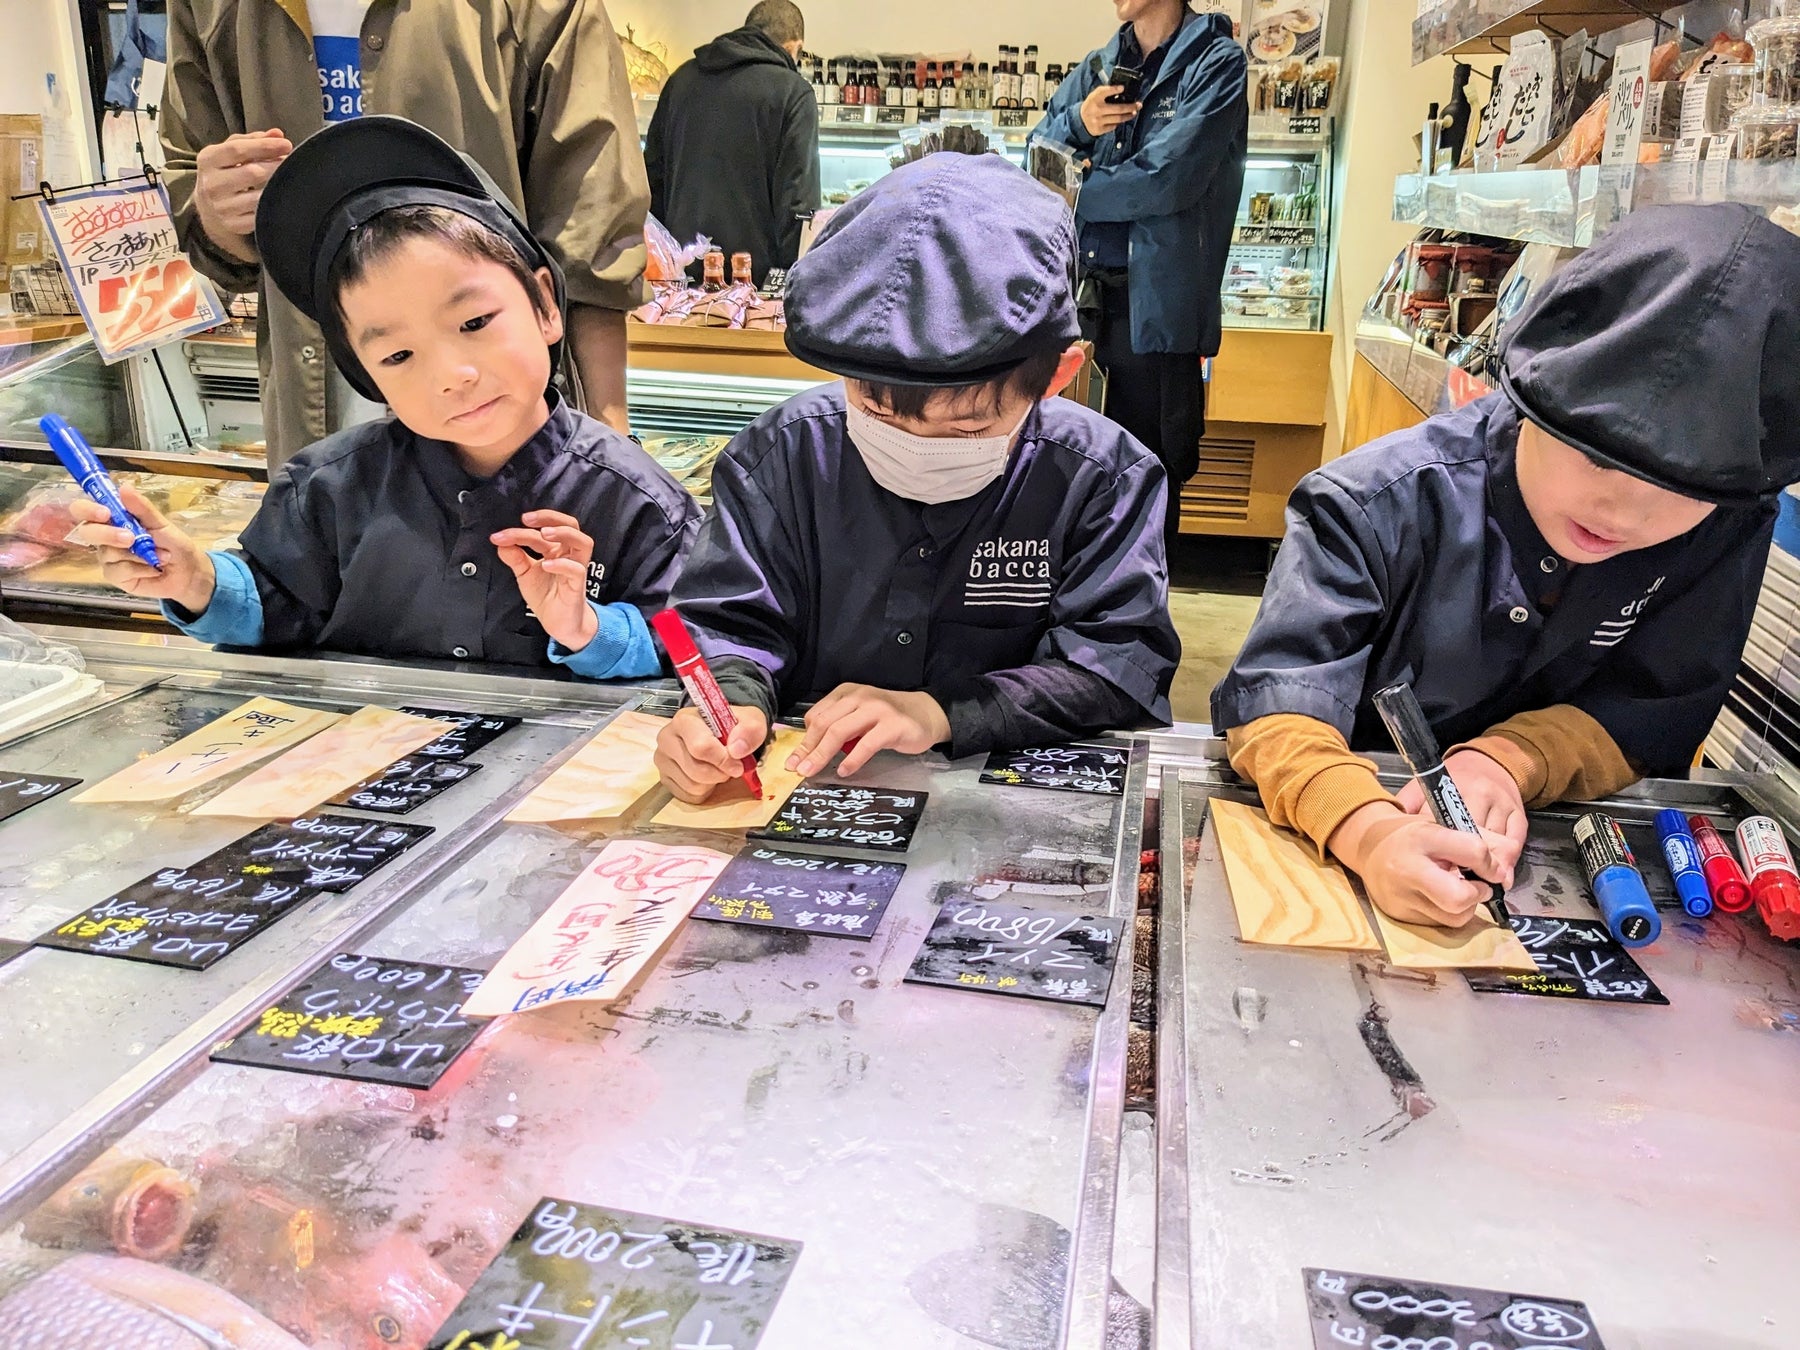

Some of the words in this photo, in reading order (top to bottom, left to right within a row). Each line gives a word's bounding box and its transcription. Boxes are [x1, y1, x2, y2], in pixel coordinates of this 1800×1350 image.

[82, 228, 174, 262] さつまあげ
[98, 259, 198, 343] 550
[972, 537, 1050, 558] sakana
[969, 558, 1050, 578] bacca
[780, 806, 904, 825] ヒラスズキ
[290, 819, 378, 843] 1200円
[251, 839, 386, 860] ニザダイ
[752, 849, 839, 871] 1200円
[594, 855, 715, 895] 580
[952, 908, 1081, 945] 1680円
[1628, 918, 1644, 940] uni
[331, 954, 452, 991] 1600円
[533, 1201, 669, 1270] 2000円
